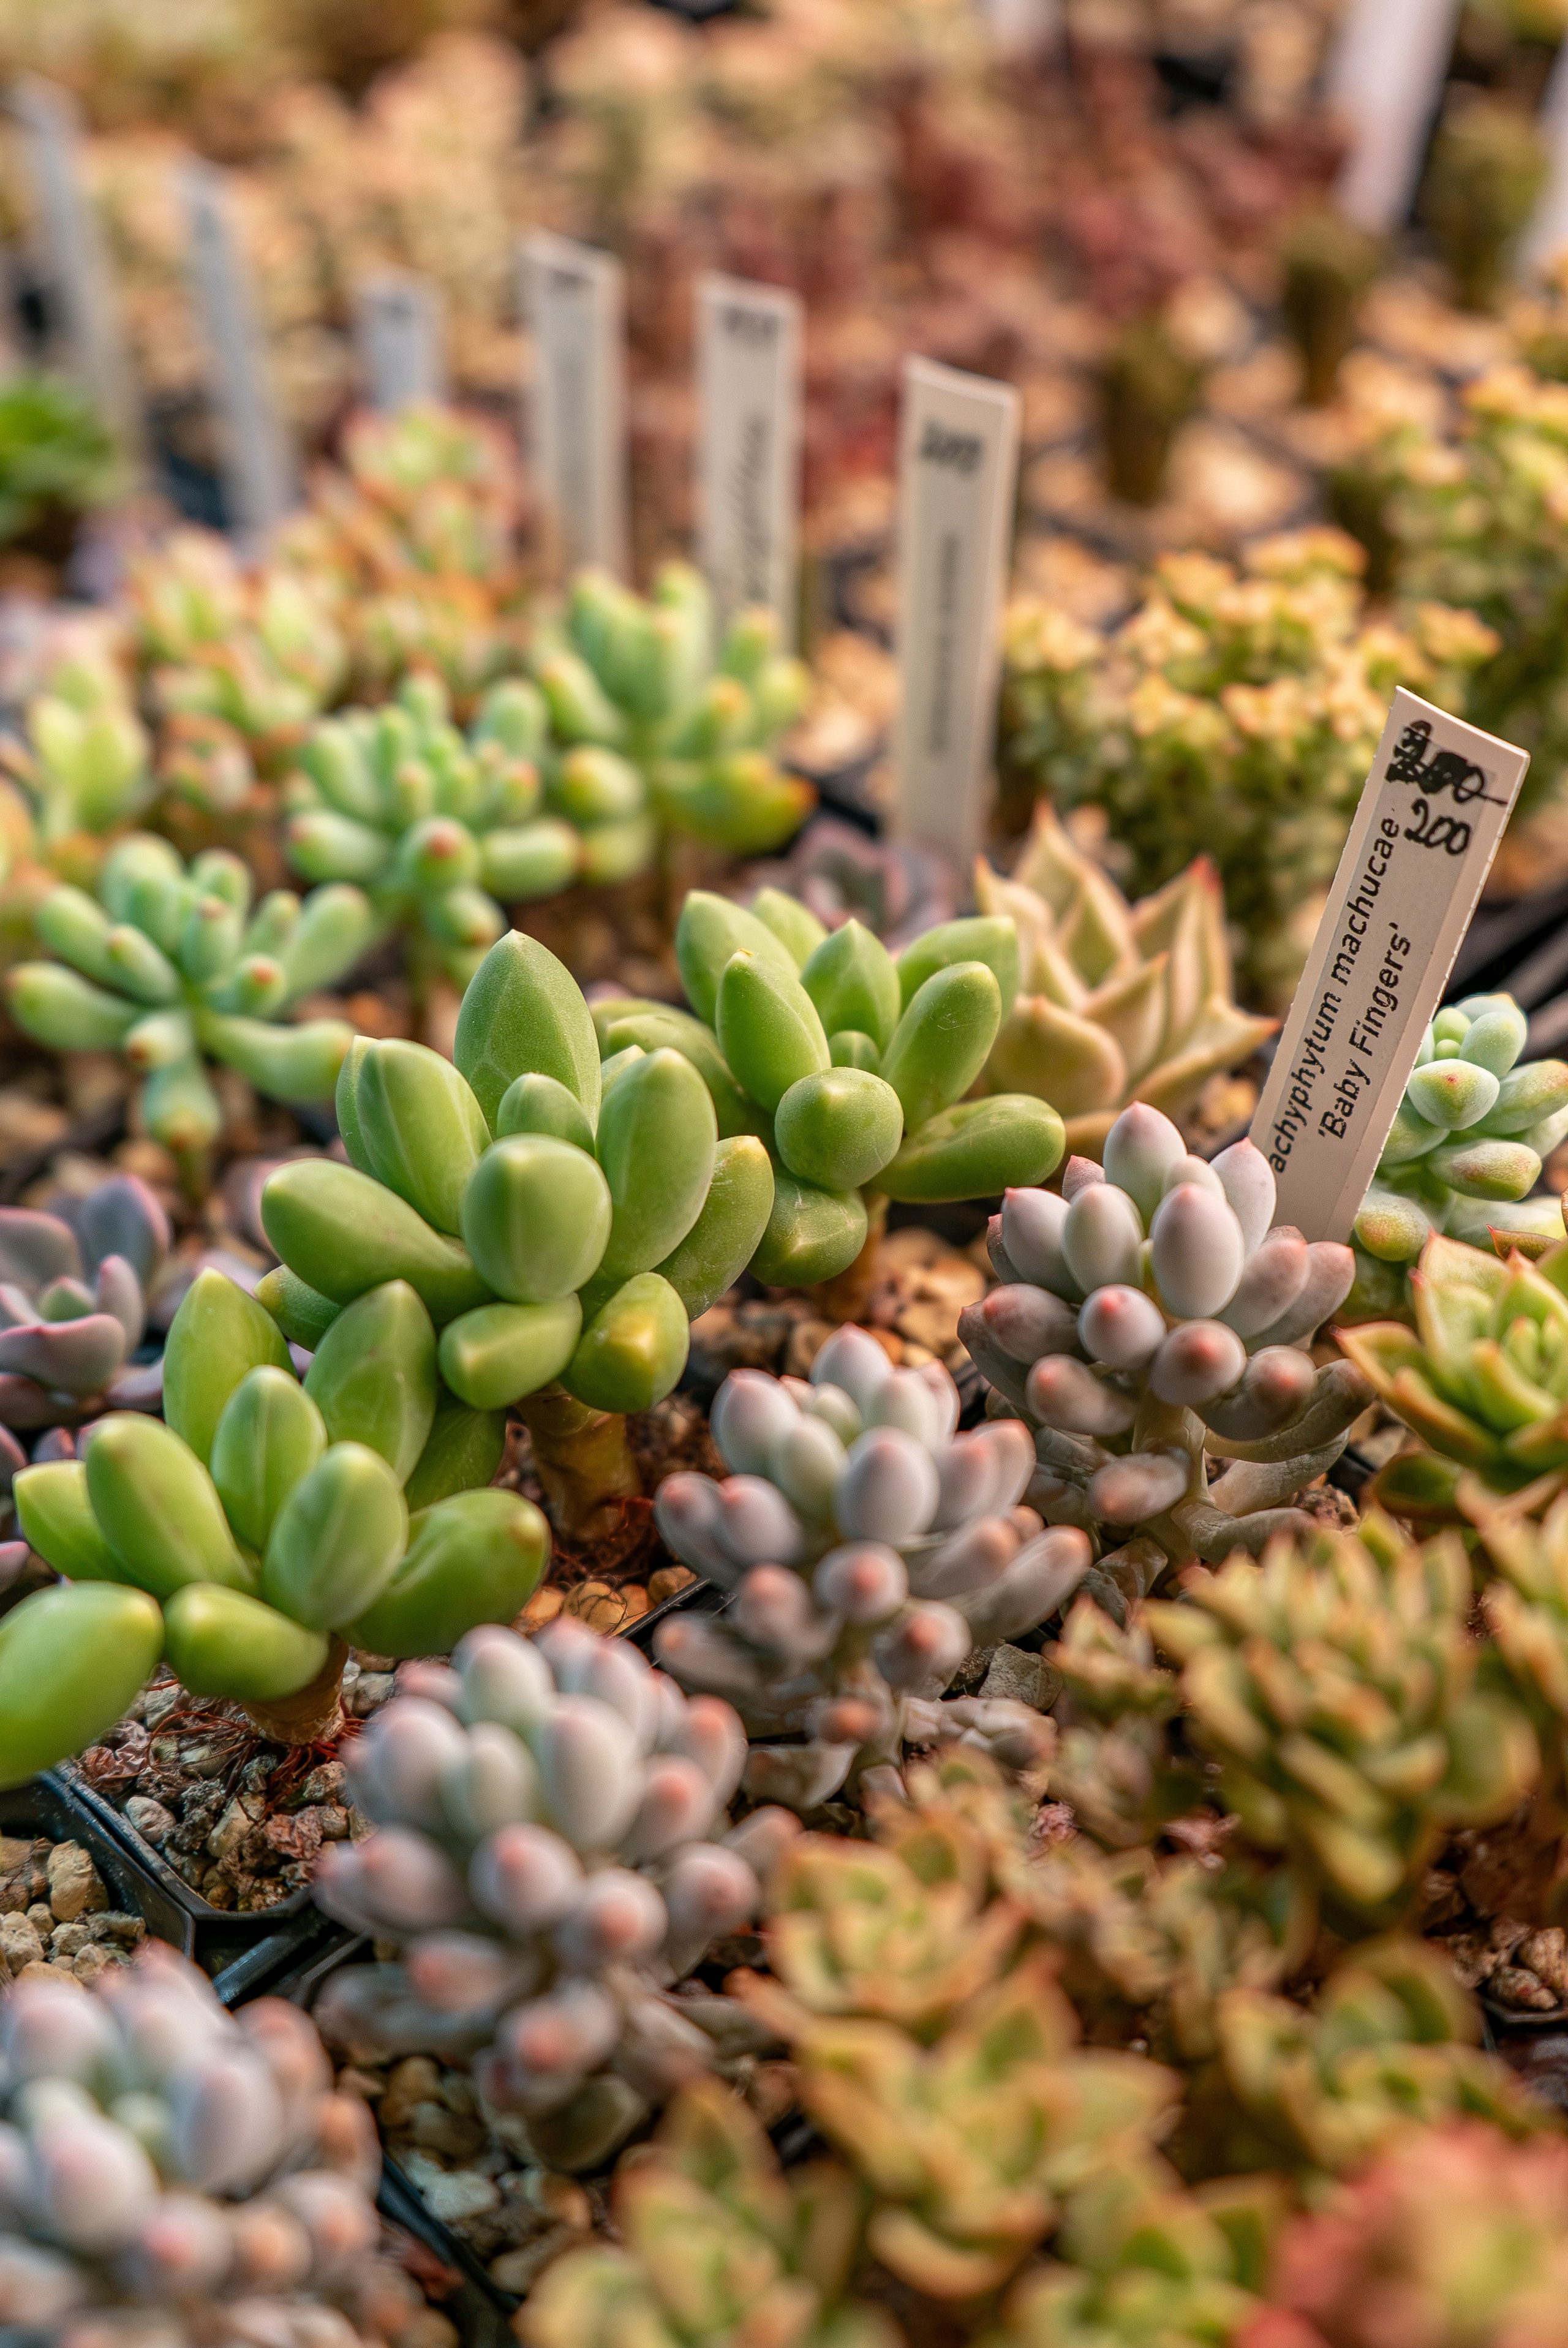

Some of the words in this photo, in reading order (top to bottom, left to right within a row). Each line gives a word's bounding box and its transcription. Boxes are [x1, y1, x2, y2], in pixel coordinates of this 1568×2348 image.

[1404, 798, 1471, 855] 200
[1269, 991, 1342, 1173] achyphytum
[1331, 818, 1400, 985] machucae
[1318, 1058, 1371, 1139] 'Baby
[1349, 921, 1411, 1057] Fingers'
